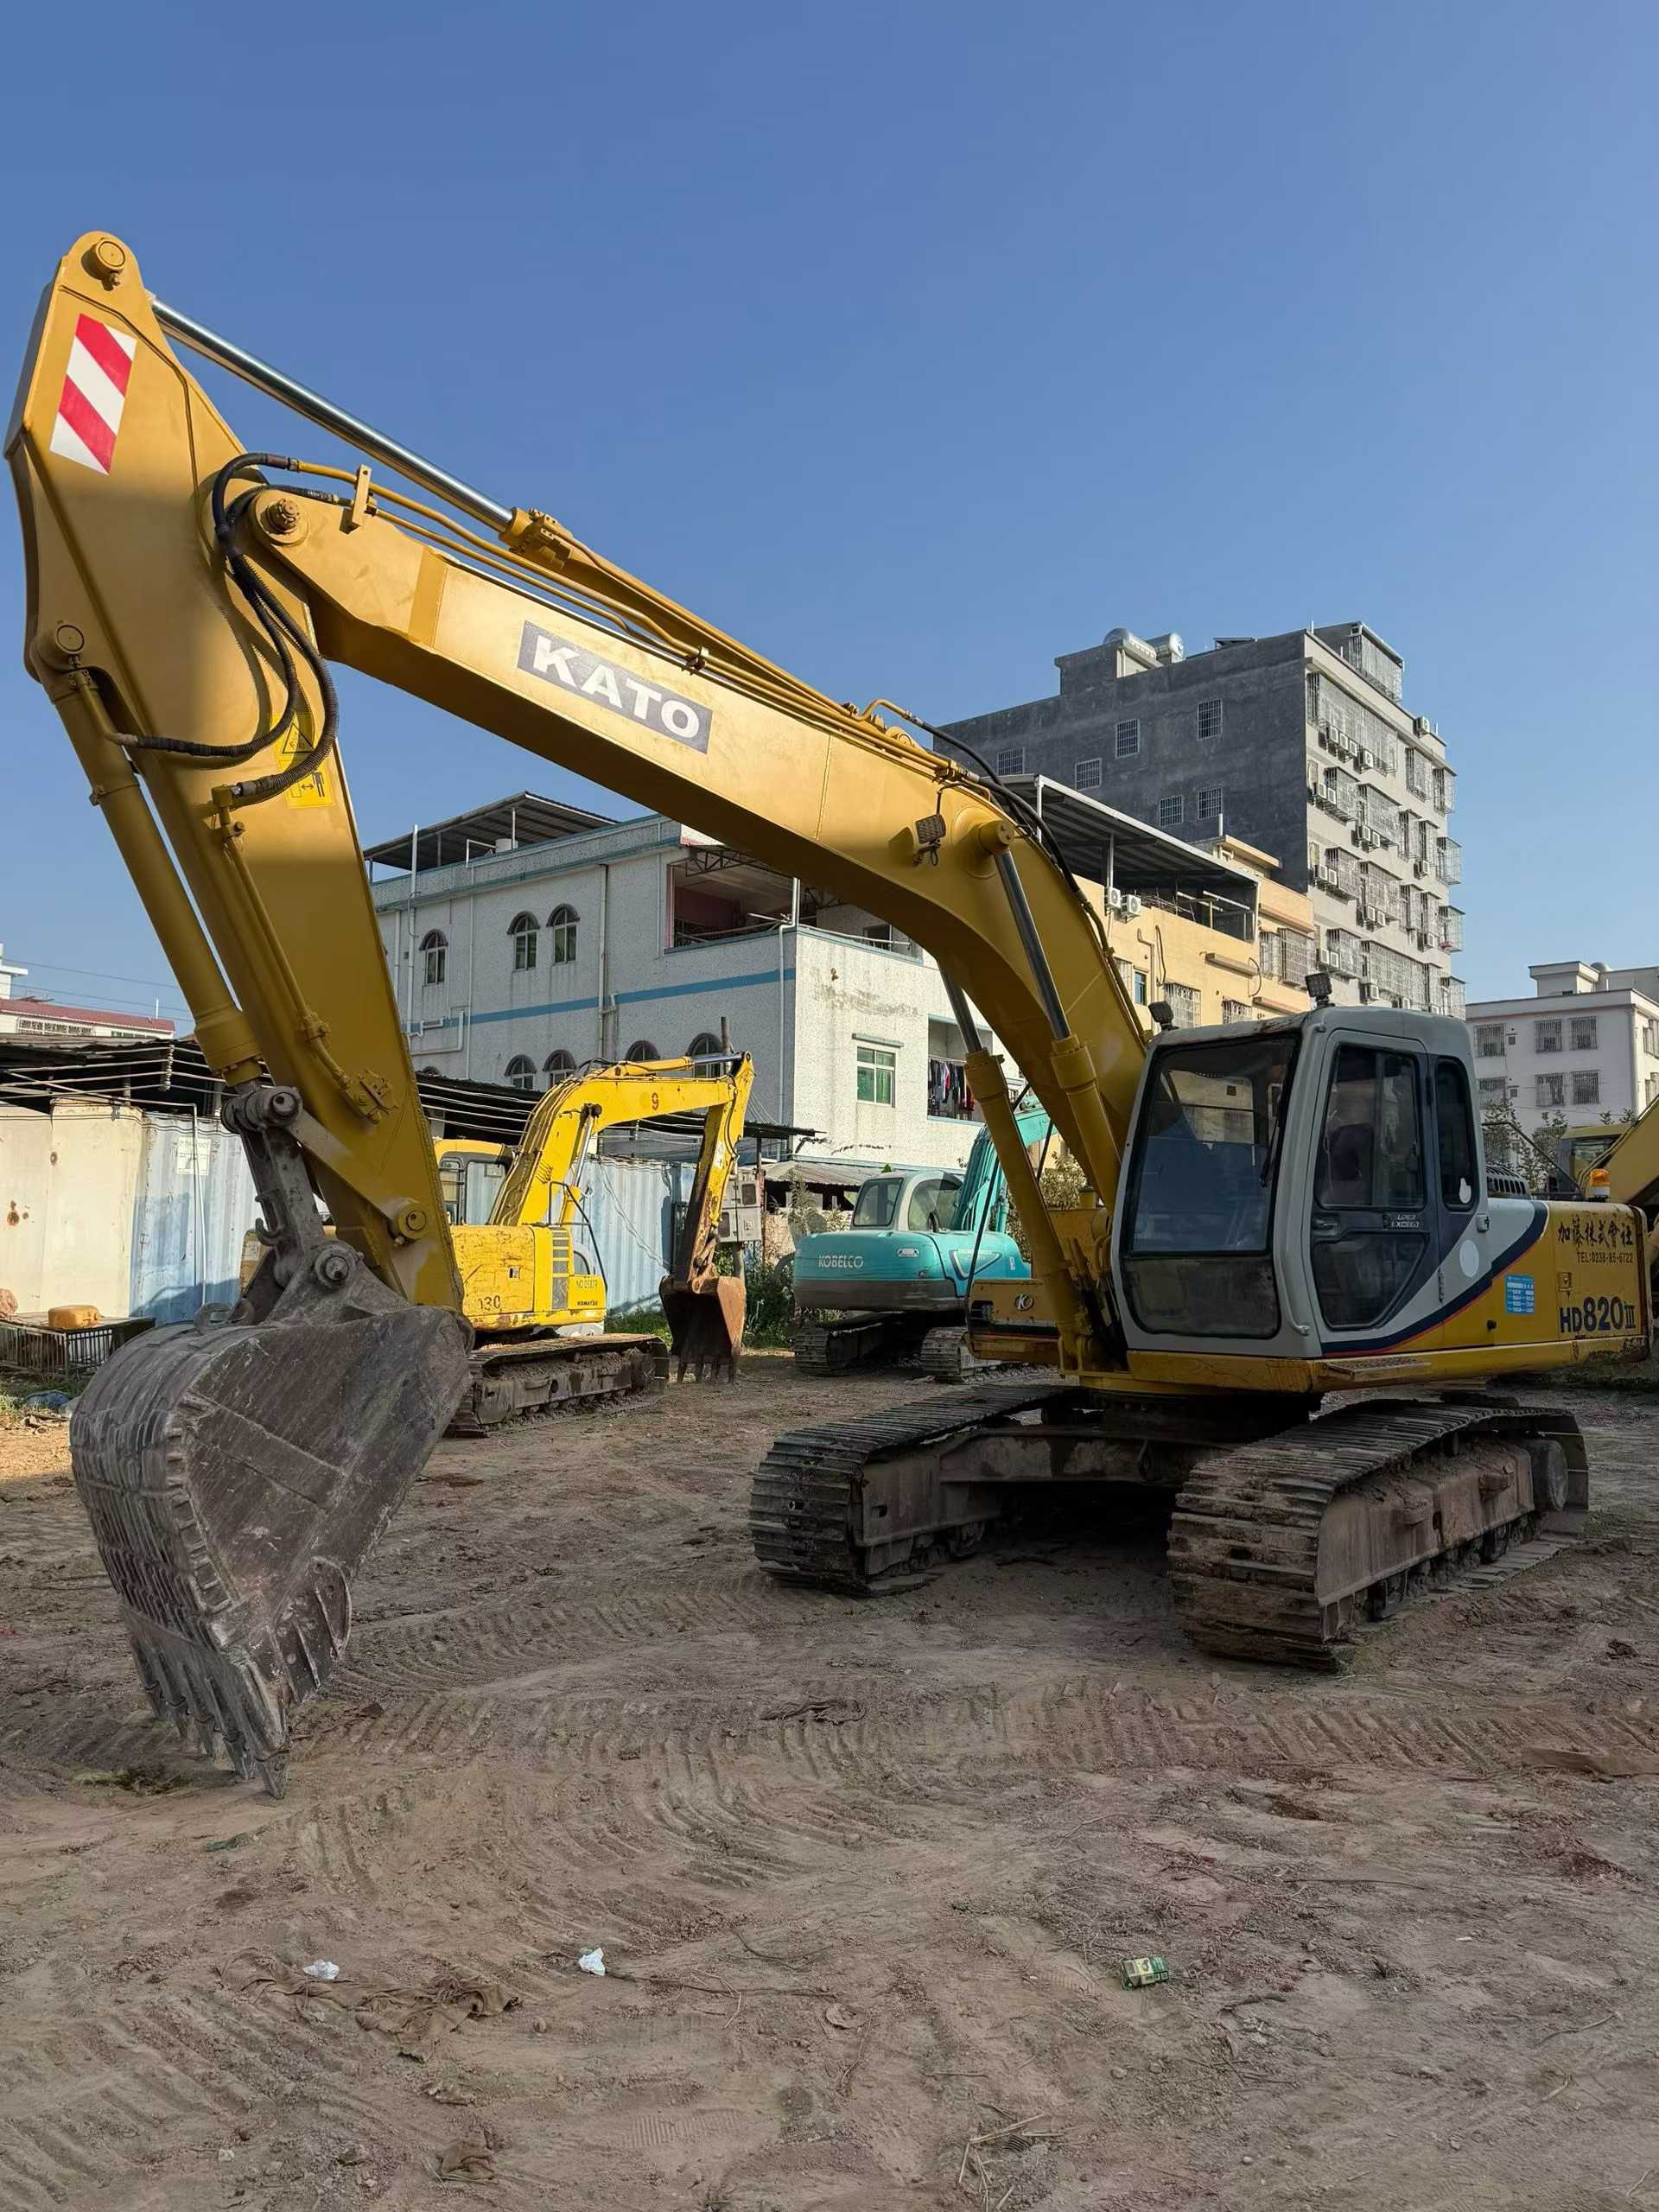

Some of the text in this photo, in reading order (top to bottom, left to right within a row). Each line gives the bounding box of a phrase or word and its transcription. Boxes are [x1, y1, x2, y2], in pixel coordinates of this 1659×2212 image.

[532, 634, 700, 738] KATO
[652, 1092, 659, 1110] 9
[818, 1255, 864, 1269] KOBELCO
